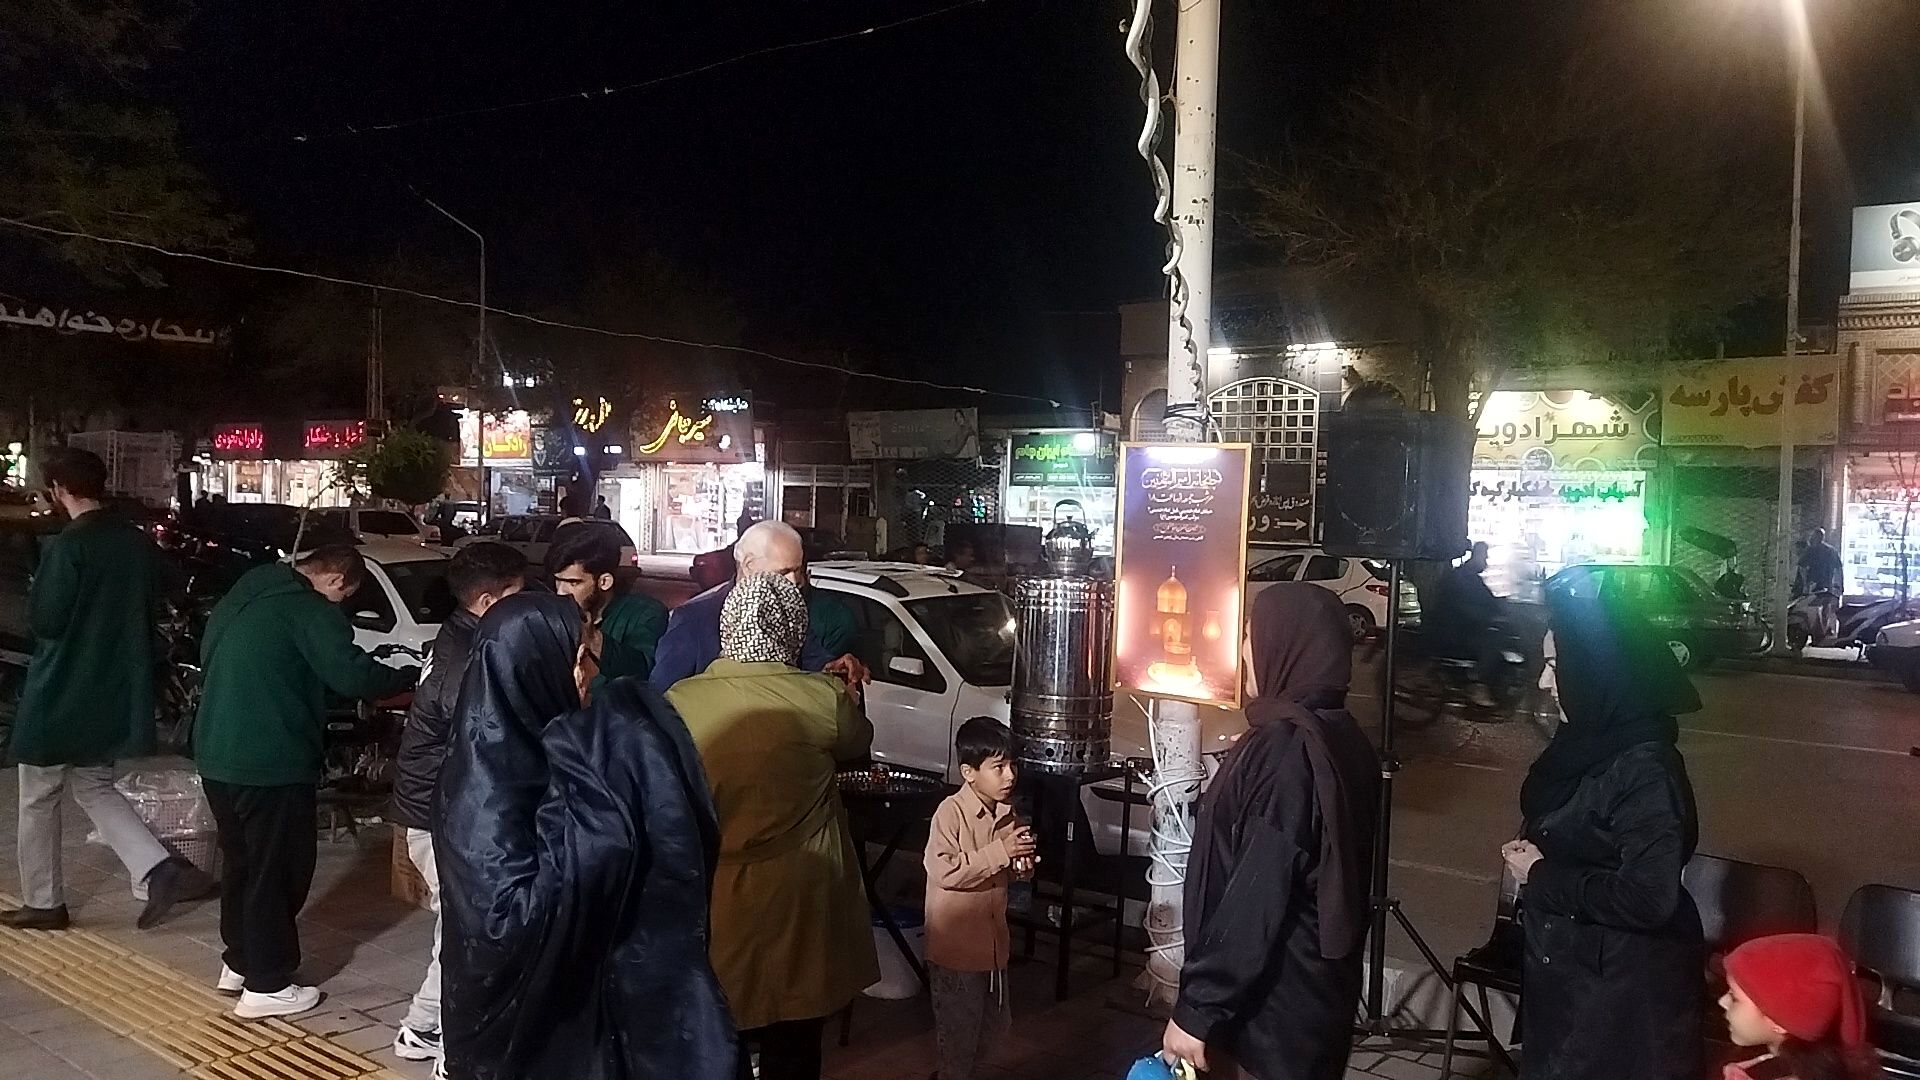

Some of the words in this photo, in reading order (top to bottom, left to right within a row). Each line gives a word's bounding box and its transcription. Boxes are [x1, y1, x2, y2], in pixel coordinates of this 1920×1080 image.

[1669, 375, 1752, 417] پارسه
[1477, 416, 1541, 446] ادوی
[1544, 409, 1630, 445] شهر
